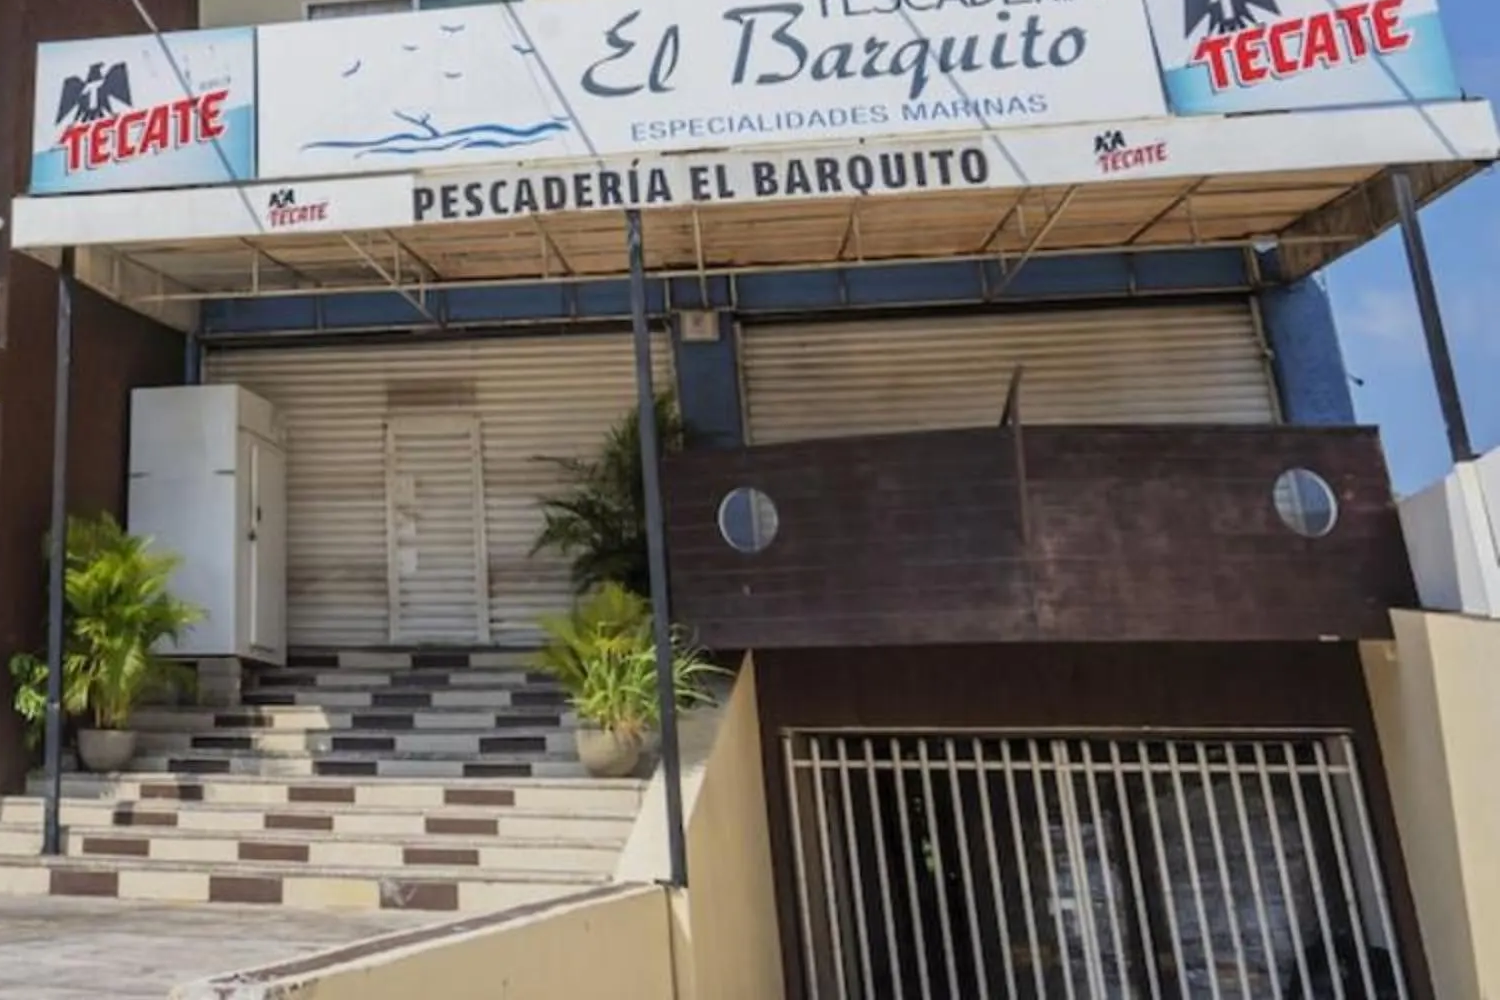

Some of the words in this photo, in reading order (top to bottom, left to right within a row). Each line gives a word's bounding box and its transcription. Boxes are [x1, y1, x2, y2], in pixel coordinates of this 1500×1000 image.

[580, 9, 679, 97] El
[723, 3, 1087, 99] Barquito
[60, 89, 229, 172] TECATE
[631, 103, 889, 142] ESPECIALIDADES
[902, 93, 1049, 124] MARINAS
[412, 158, 673, 221] PESCADERÍA
[690, 165, 734, 202] EL
[755, 147, 989, 196] BARQUITO
[1100, 142, 1167, 173] TECATE
[268, 202, 328, 227] TECATE
